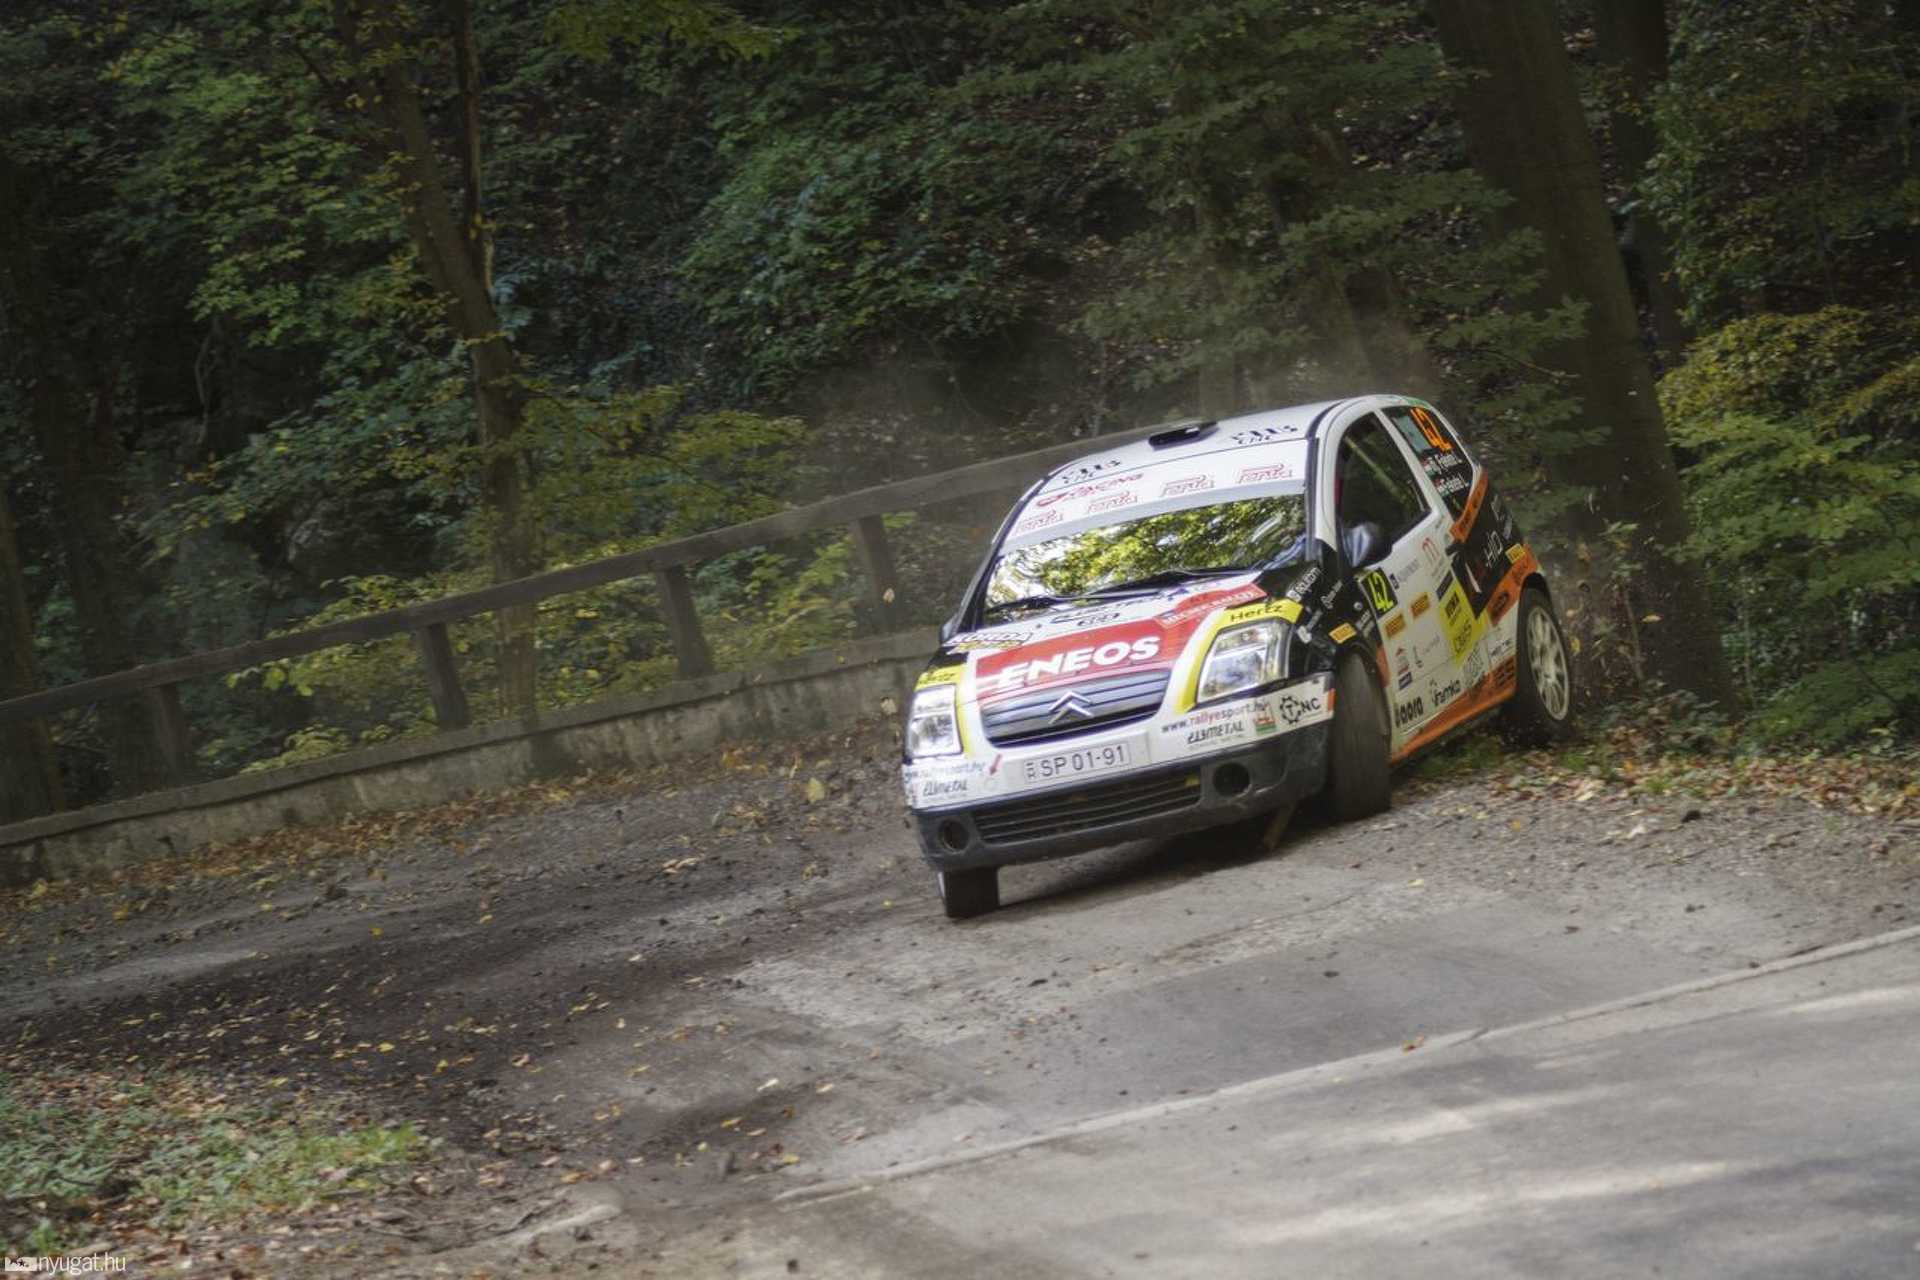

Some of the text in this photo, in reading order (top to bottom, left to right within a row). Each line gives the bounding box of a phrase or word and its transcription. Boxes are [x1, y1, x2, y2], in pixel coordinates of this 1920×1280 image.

[1366, 571, 1394, 613] 42
[1230, 602, 1283, 622] Hertz
[1000, 635, 1162, 690] ENEOS
[1040, 756, 1067, 777] SP
[1072, 745, 1124, 771] 01-91
